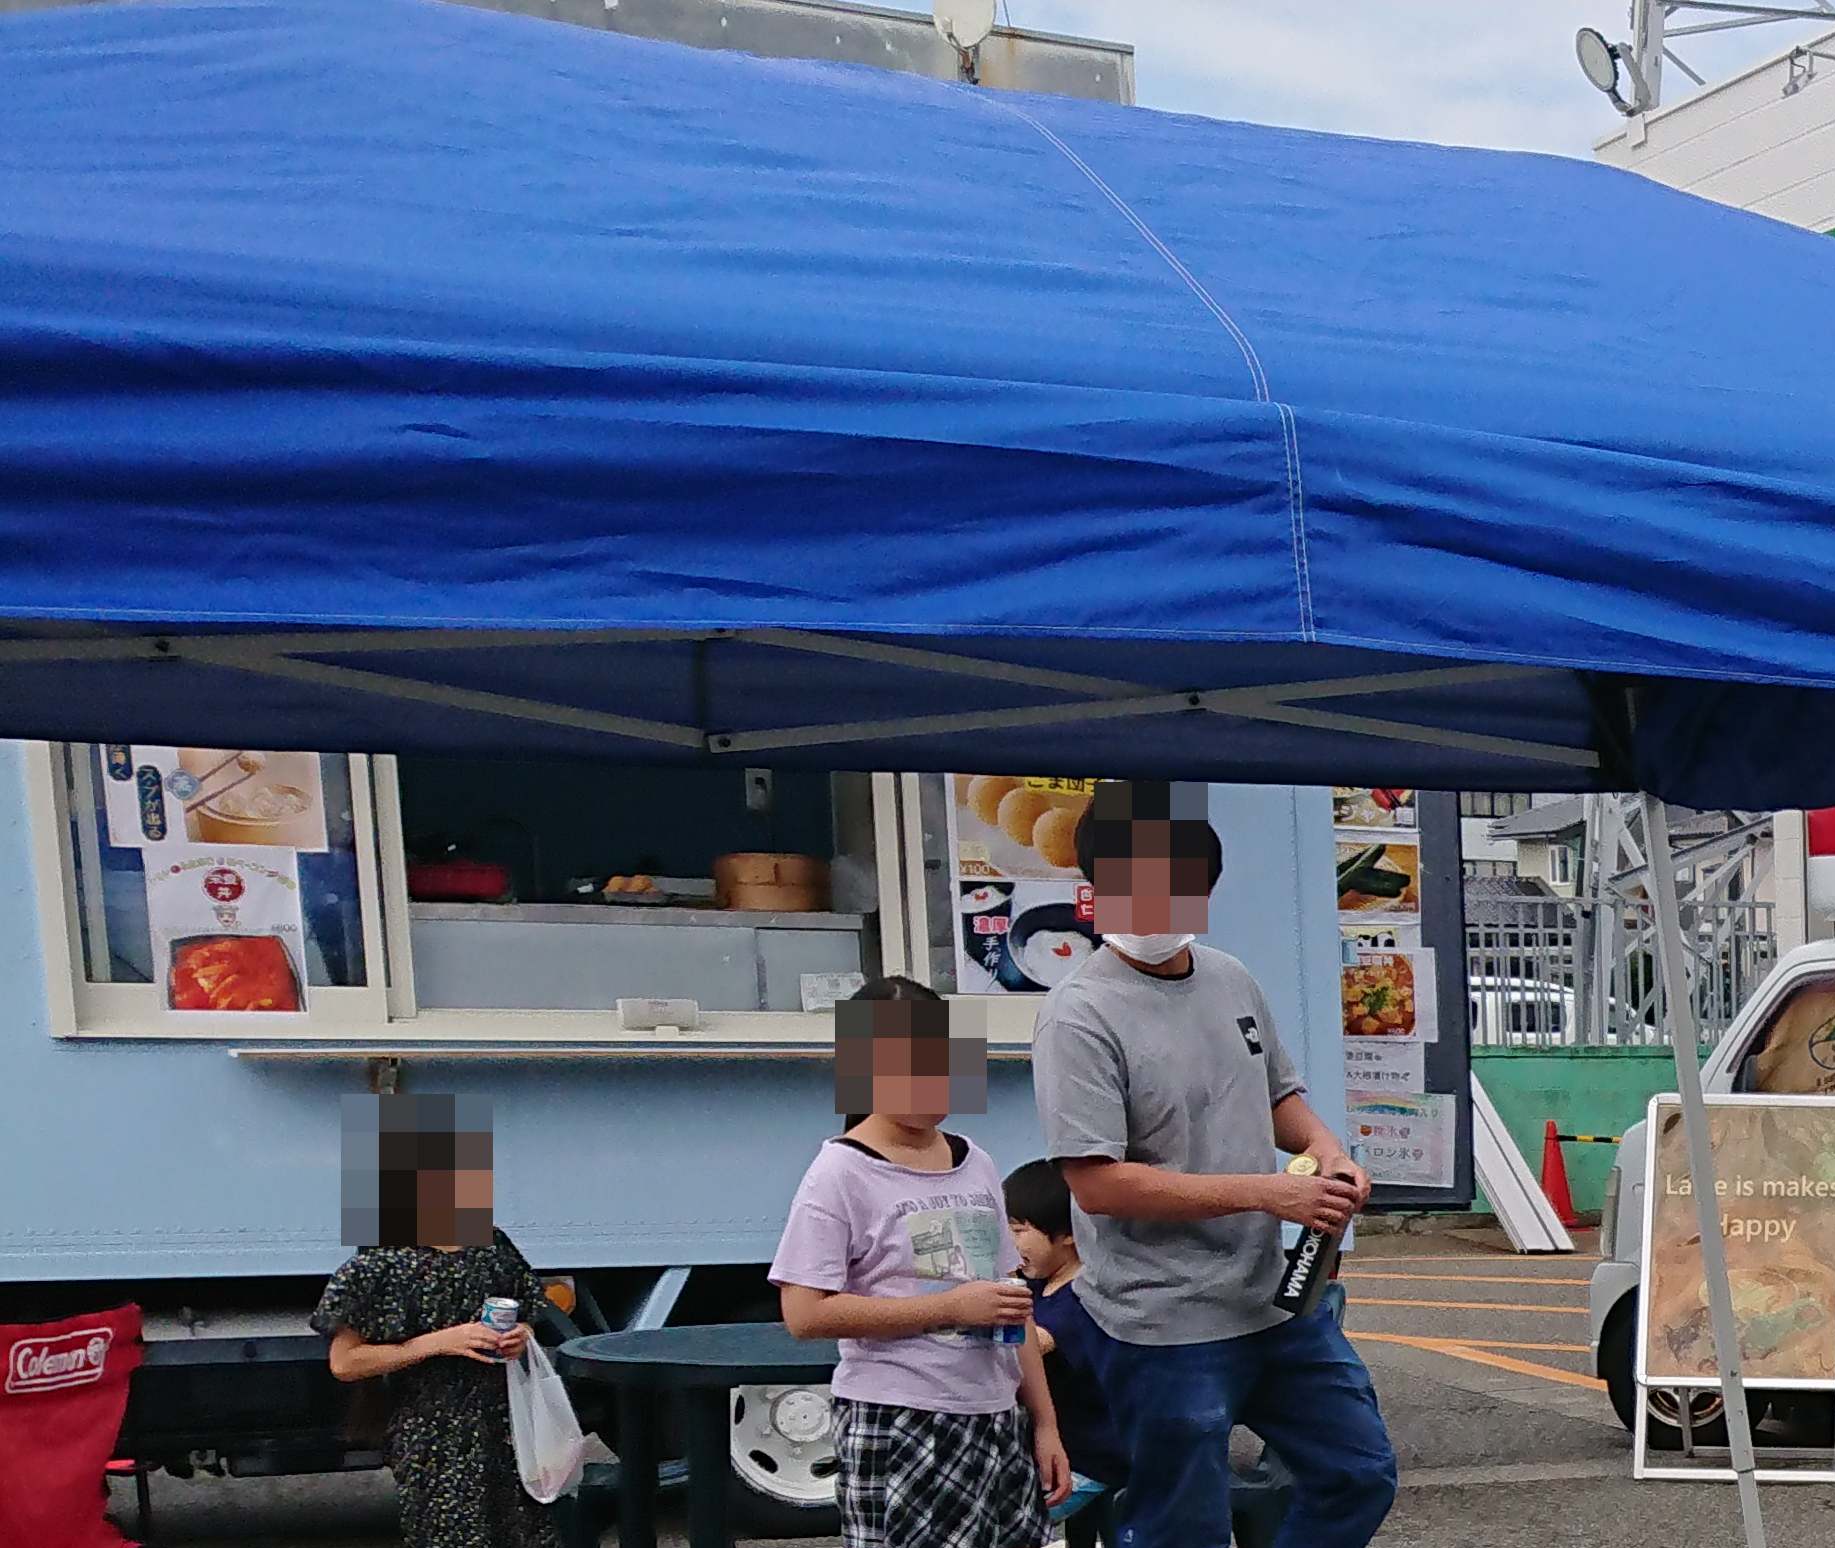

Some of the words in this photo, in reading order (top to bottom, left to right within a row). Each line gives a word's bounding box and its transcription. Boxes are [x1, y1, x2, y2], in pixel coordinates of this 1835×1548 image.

[982, 936, 1001, 992] 手作り
[1665, 1174, 1728, 1196] Lae
[1736, 1175, 1754, 1197] is
[16, 1346, 87, 1380] Coleman
